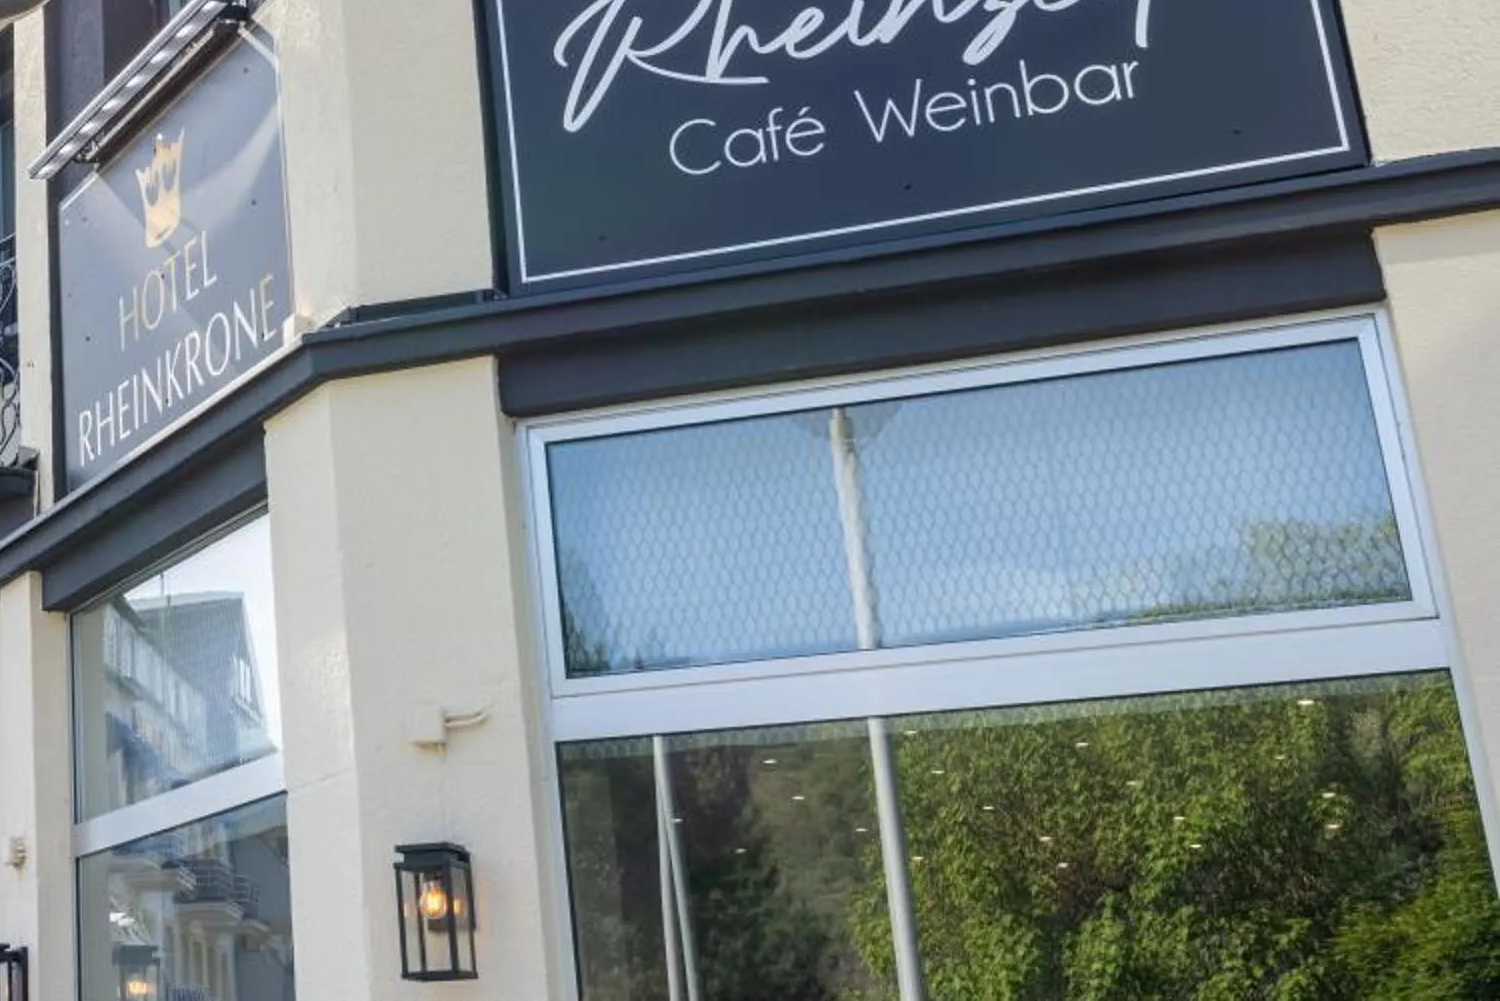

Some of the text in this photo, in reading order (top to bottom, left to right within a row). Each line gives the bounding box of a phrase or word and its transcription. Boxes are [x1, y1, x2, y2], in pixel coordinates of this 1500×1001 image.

[668, 54, 1141, 176] Café Weinbar
[117, 229, 218, 353] HOTEL
[77, 272, 280, 468] RHEINKRONE
